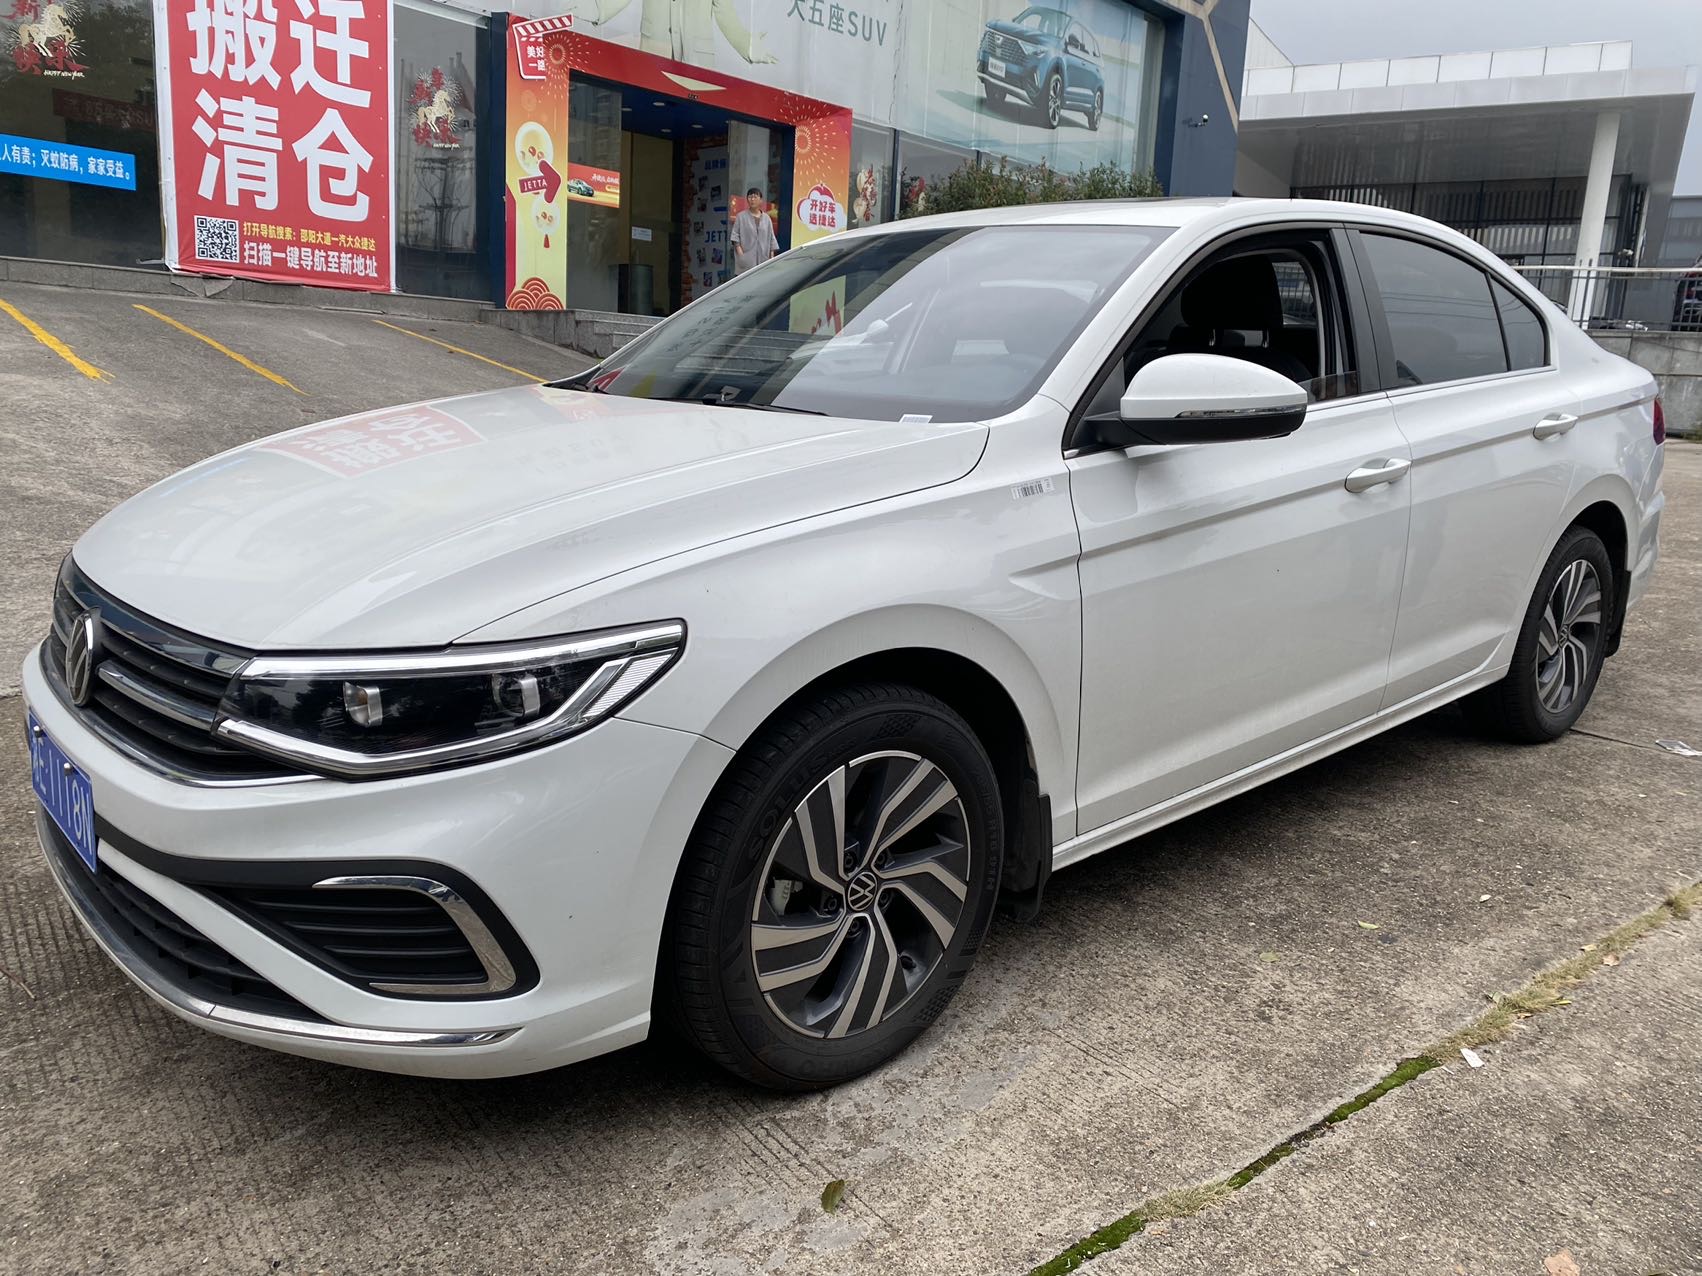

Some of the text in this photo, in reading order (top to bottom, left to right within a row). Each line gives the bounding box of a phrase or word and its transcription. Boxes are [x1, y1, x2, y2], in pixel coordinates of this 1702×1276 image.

[186, 0, 372, 108] 搬迁
[527, 45, 544, 58] 美好
[0, 143, 131, 180] 人有责；灭蚊防病，家家受益。
[192, 88, 373, 222] 清仓
[523, 178, 547, 191] JETTA
[809, 199, 836, 214] 开好车
[808, 213, 836, 228] 选捷达
[244, 241, 378, 278] 扫描一键导航至新地址
